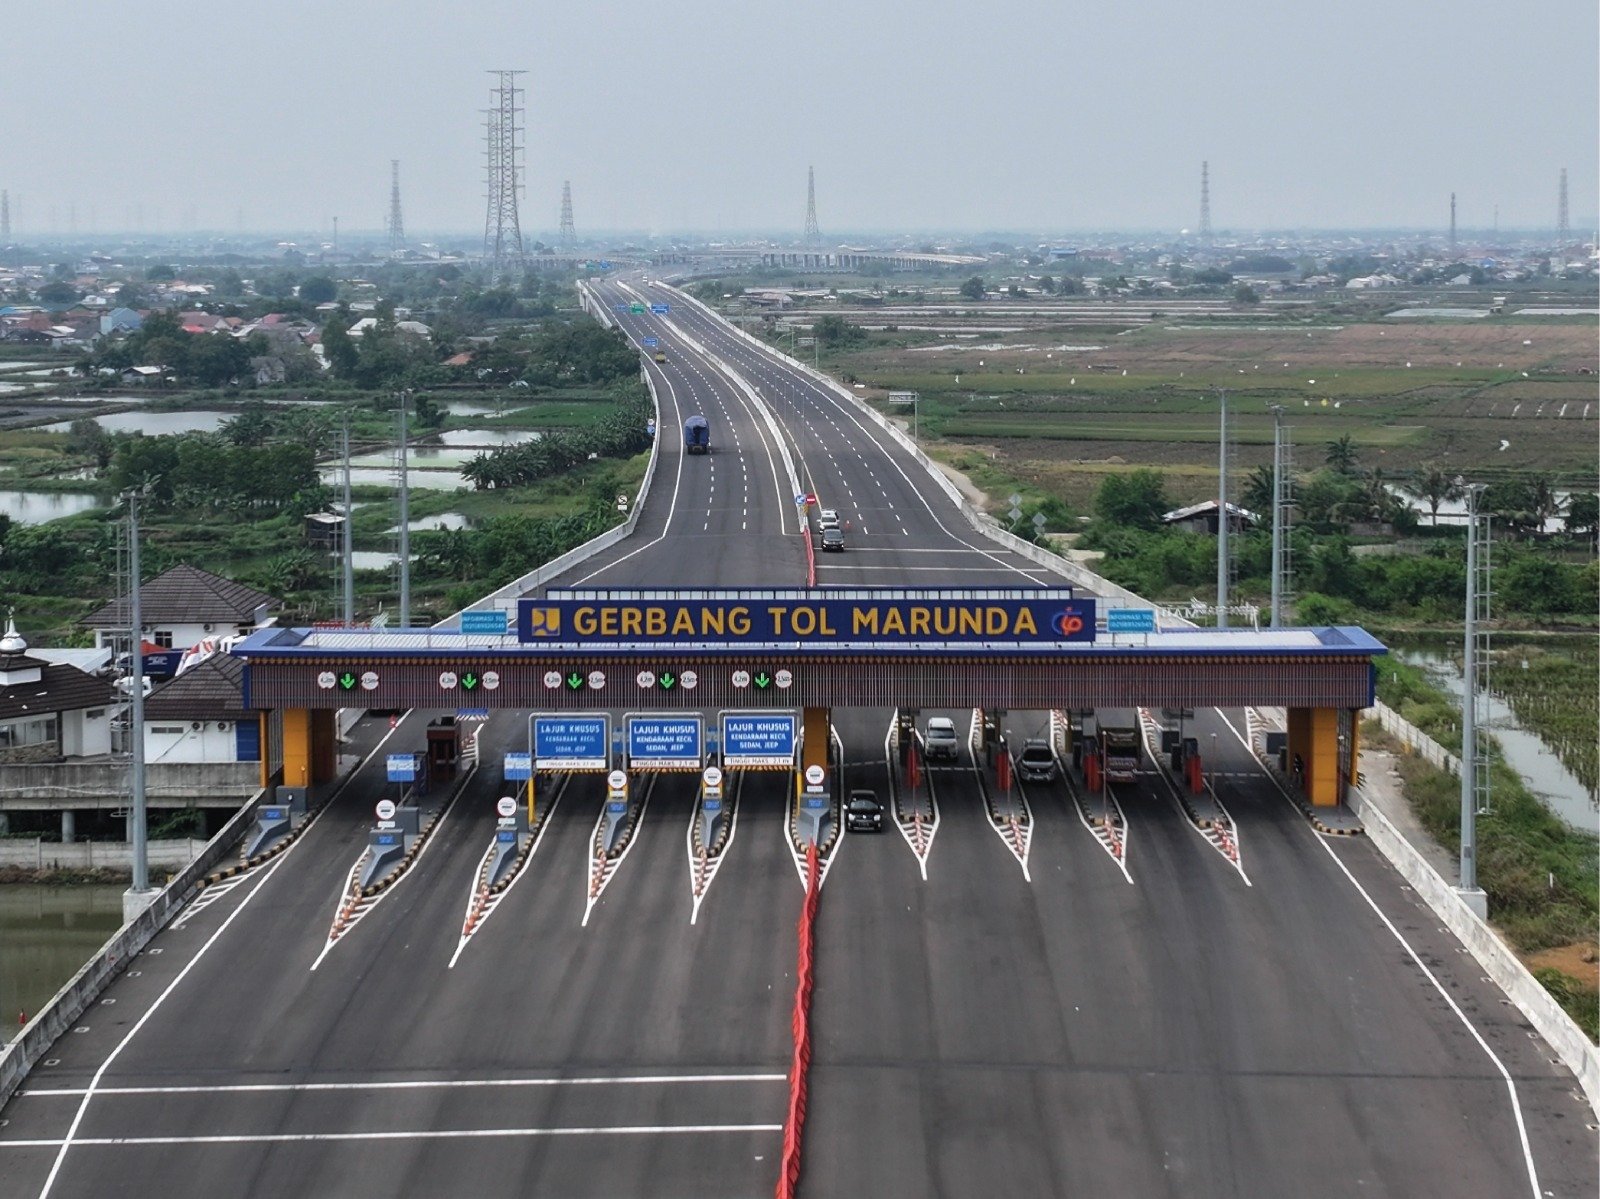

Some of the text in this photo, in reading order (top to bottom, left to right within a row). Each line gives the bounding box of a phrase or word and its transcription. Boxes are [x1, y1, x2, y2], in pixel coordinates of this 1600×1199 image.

[573, 606, 751, 635] GERBANG
[767, 606, 836, 635] TOL
[852, 606, 1038, 635] MARUNDA
[541, 724, 600, 733] LAJUR KHUSUS
[633, 725, 696, 734] LAJUR KHUSUS
[728, 723, 790, 731] LAJUR KHUSUS
[636, 735, 693, 743] KENDARAAN KECIL
[670, 744, 684, 752] JEEP
[764, 741, 779, 749] JEEP
